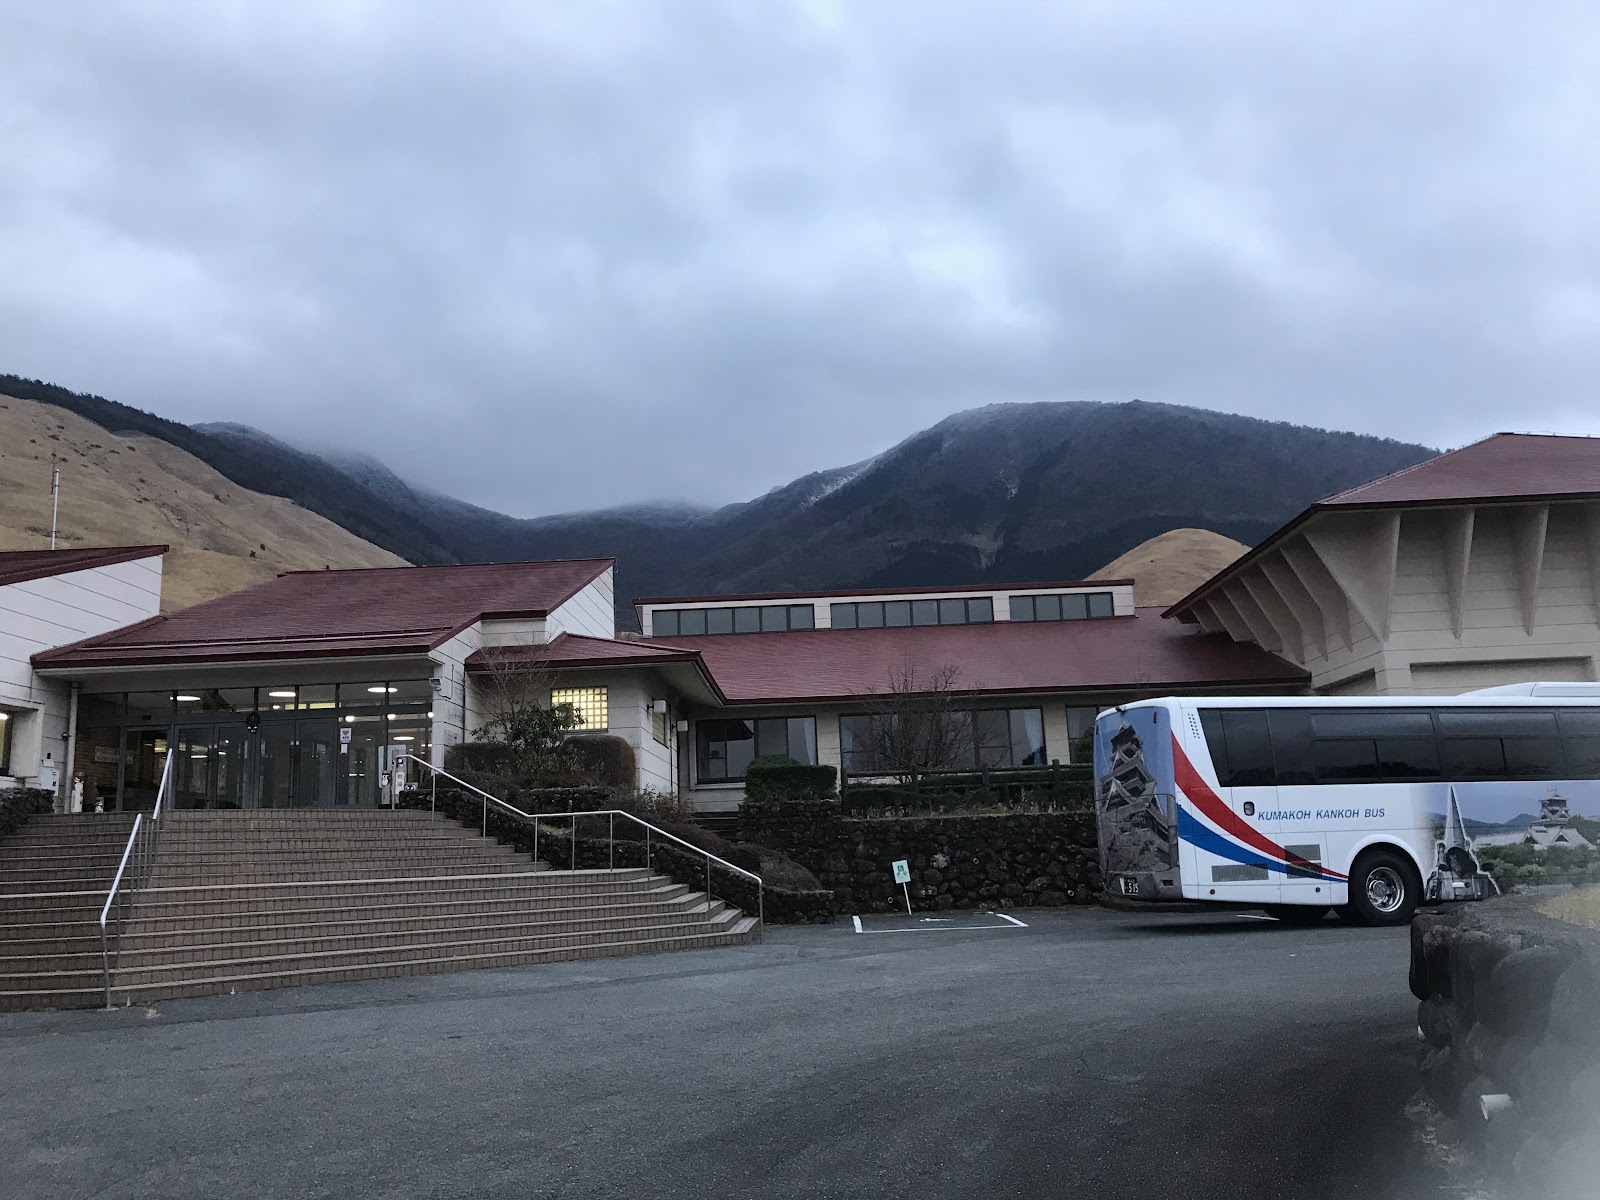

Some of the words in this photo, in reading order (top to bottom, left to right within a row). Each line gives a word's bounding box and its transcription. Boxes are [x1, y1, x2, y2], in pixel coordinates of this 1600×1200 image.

[1258, 810, 1311, 820] KUMAKOH
[1316, 809, 1360, 819] KANKOH
[1364, 808, 1386, 818] BUS
